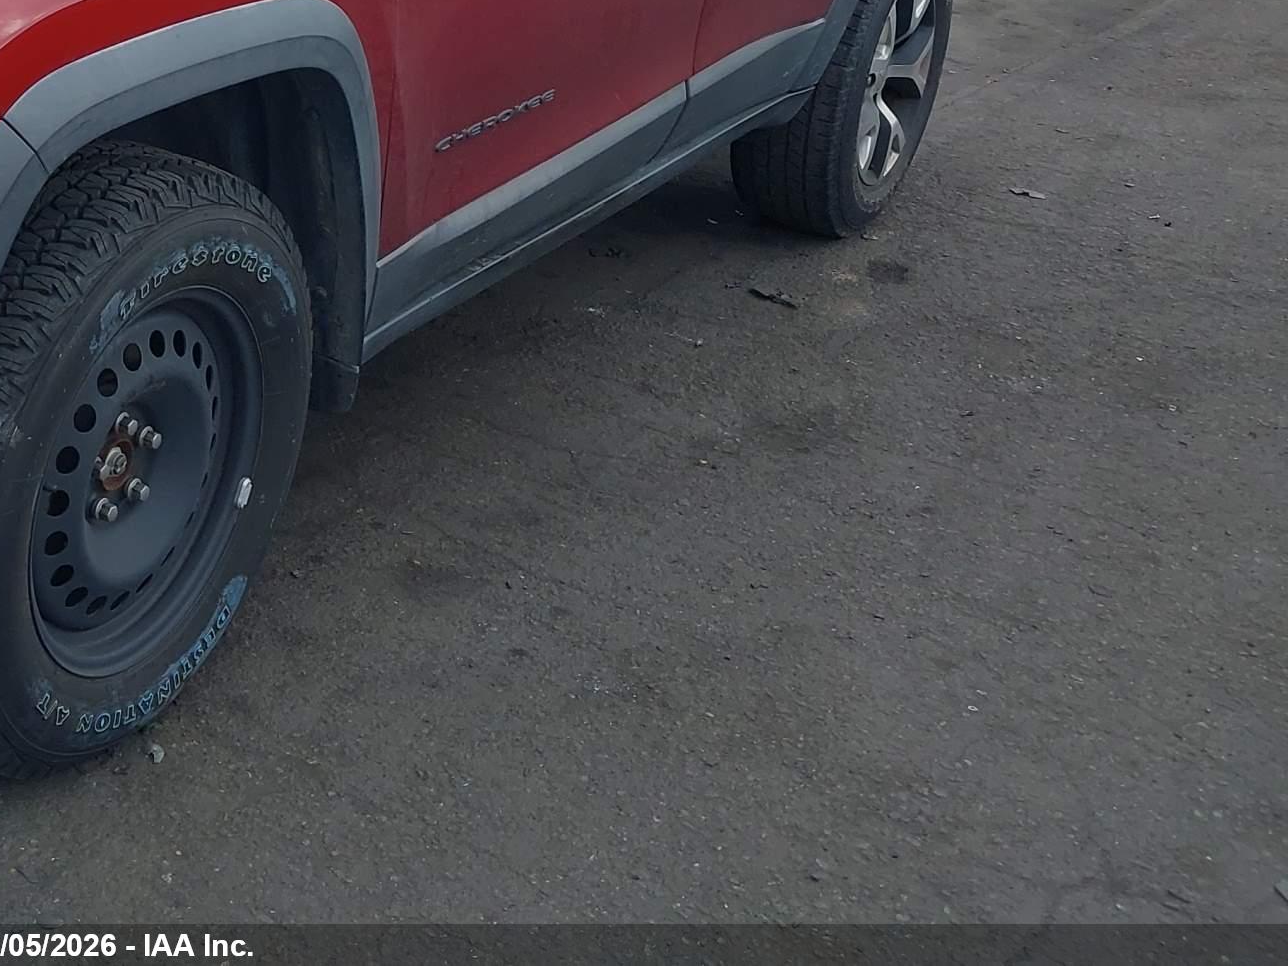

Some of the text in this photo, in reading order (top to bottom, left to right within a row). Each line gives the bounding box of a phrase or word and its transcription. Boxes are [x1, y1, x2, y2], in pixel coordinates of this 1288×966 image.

[435, 89, 556, 152] CHEROKEE
[36, 604, 231, 733] DESTINATION A/T
